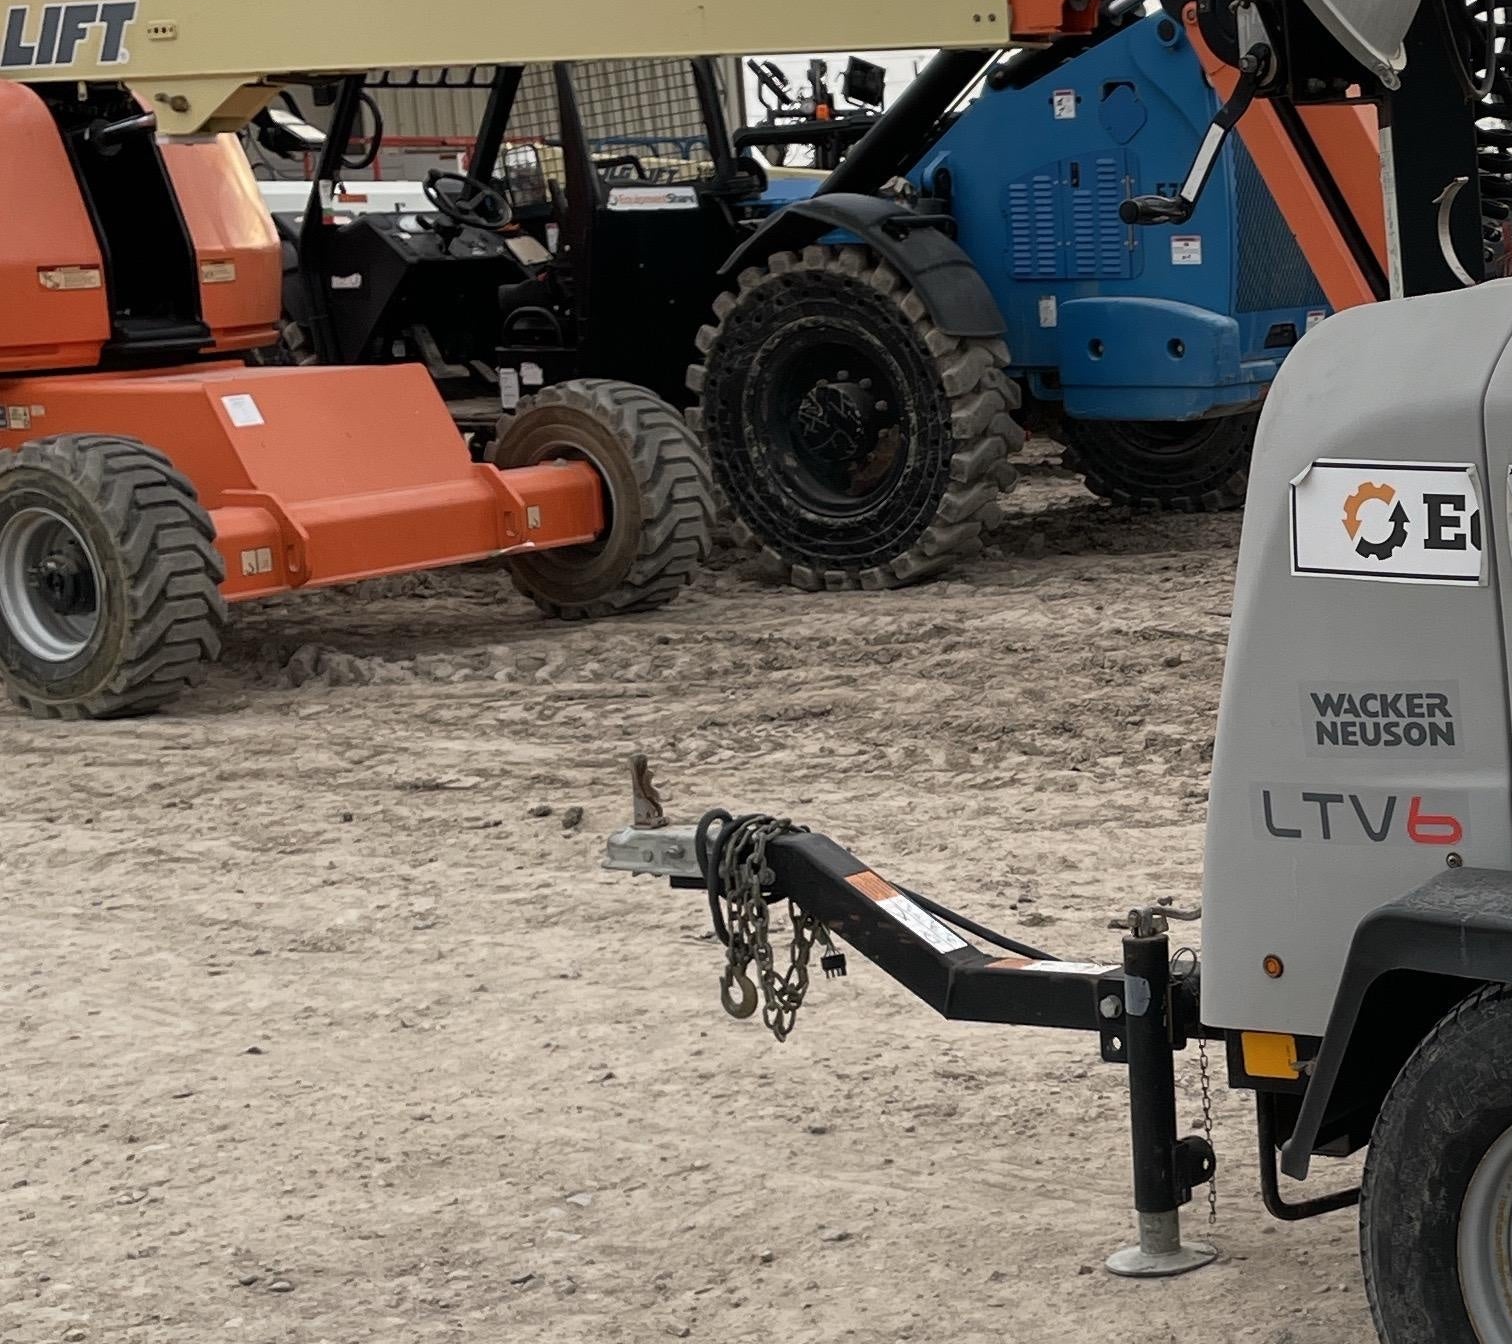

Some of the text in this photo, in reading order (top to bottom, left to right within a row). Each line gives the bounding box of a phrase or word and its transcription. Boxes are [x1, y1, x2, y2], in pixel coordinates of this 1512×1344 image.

[0, 0, 139, 69] LIFT
[1310, 692, 1453, 719] WACKER
[1316, 720, 1456, 746] NEUSON
[1262, 789, 1463, 846] LTV6
